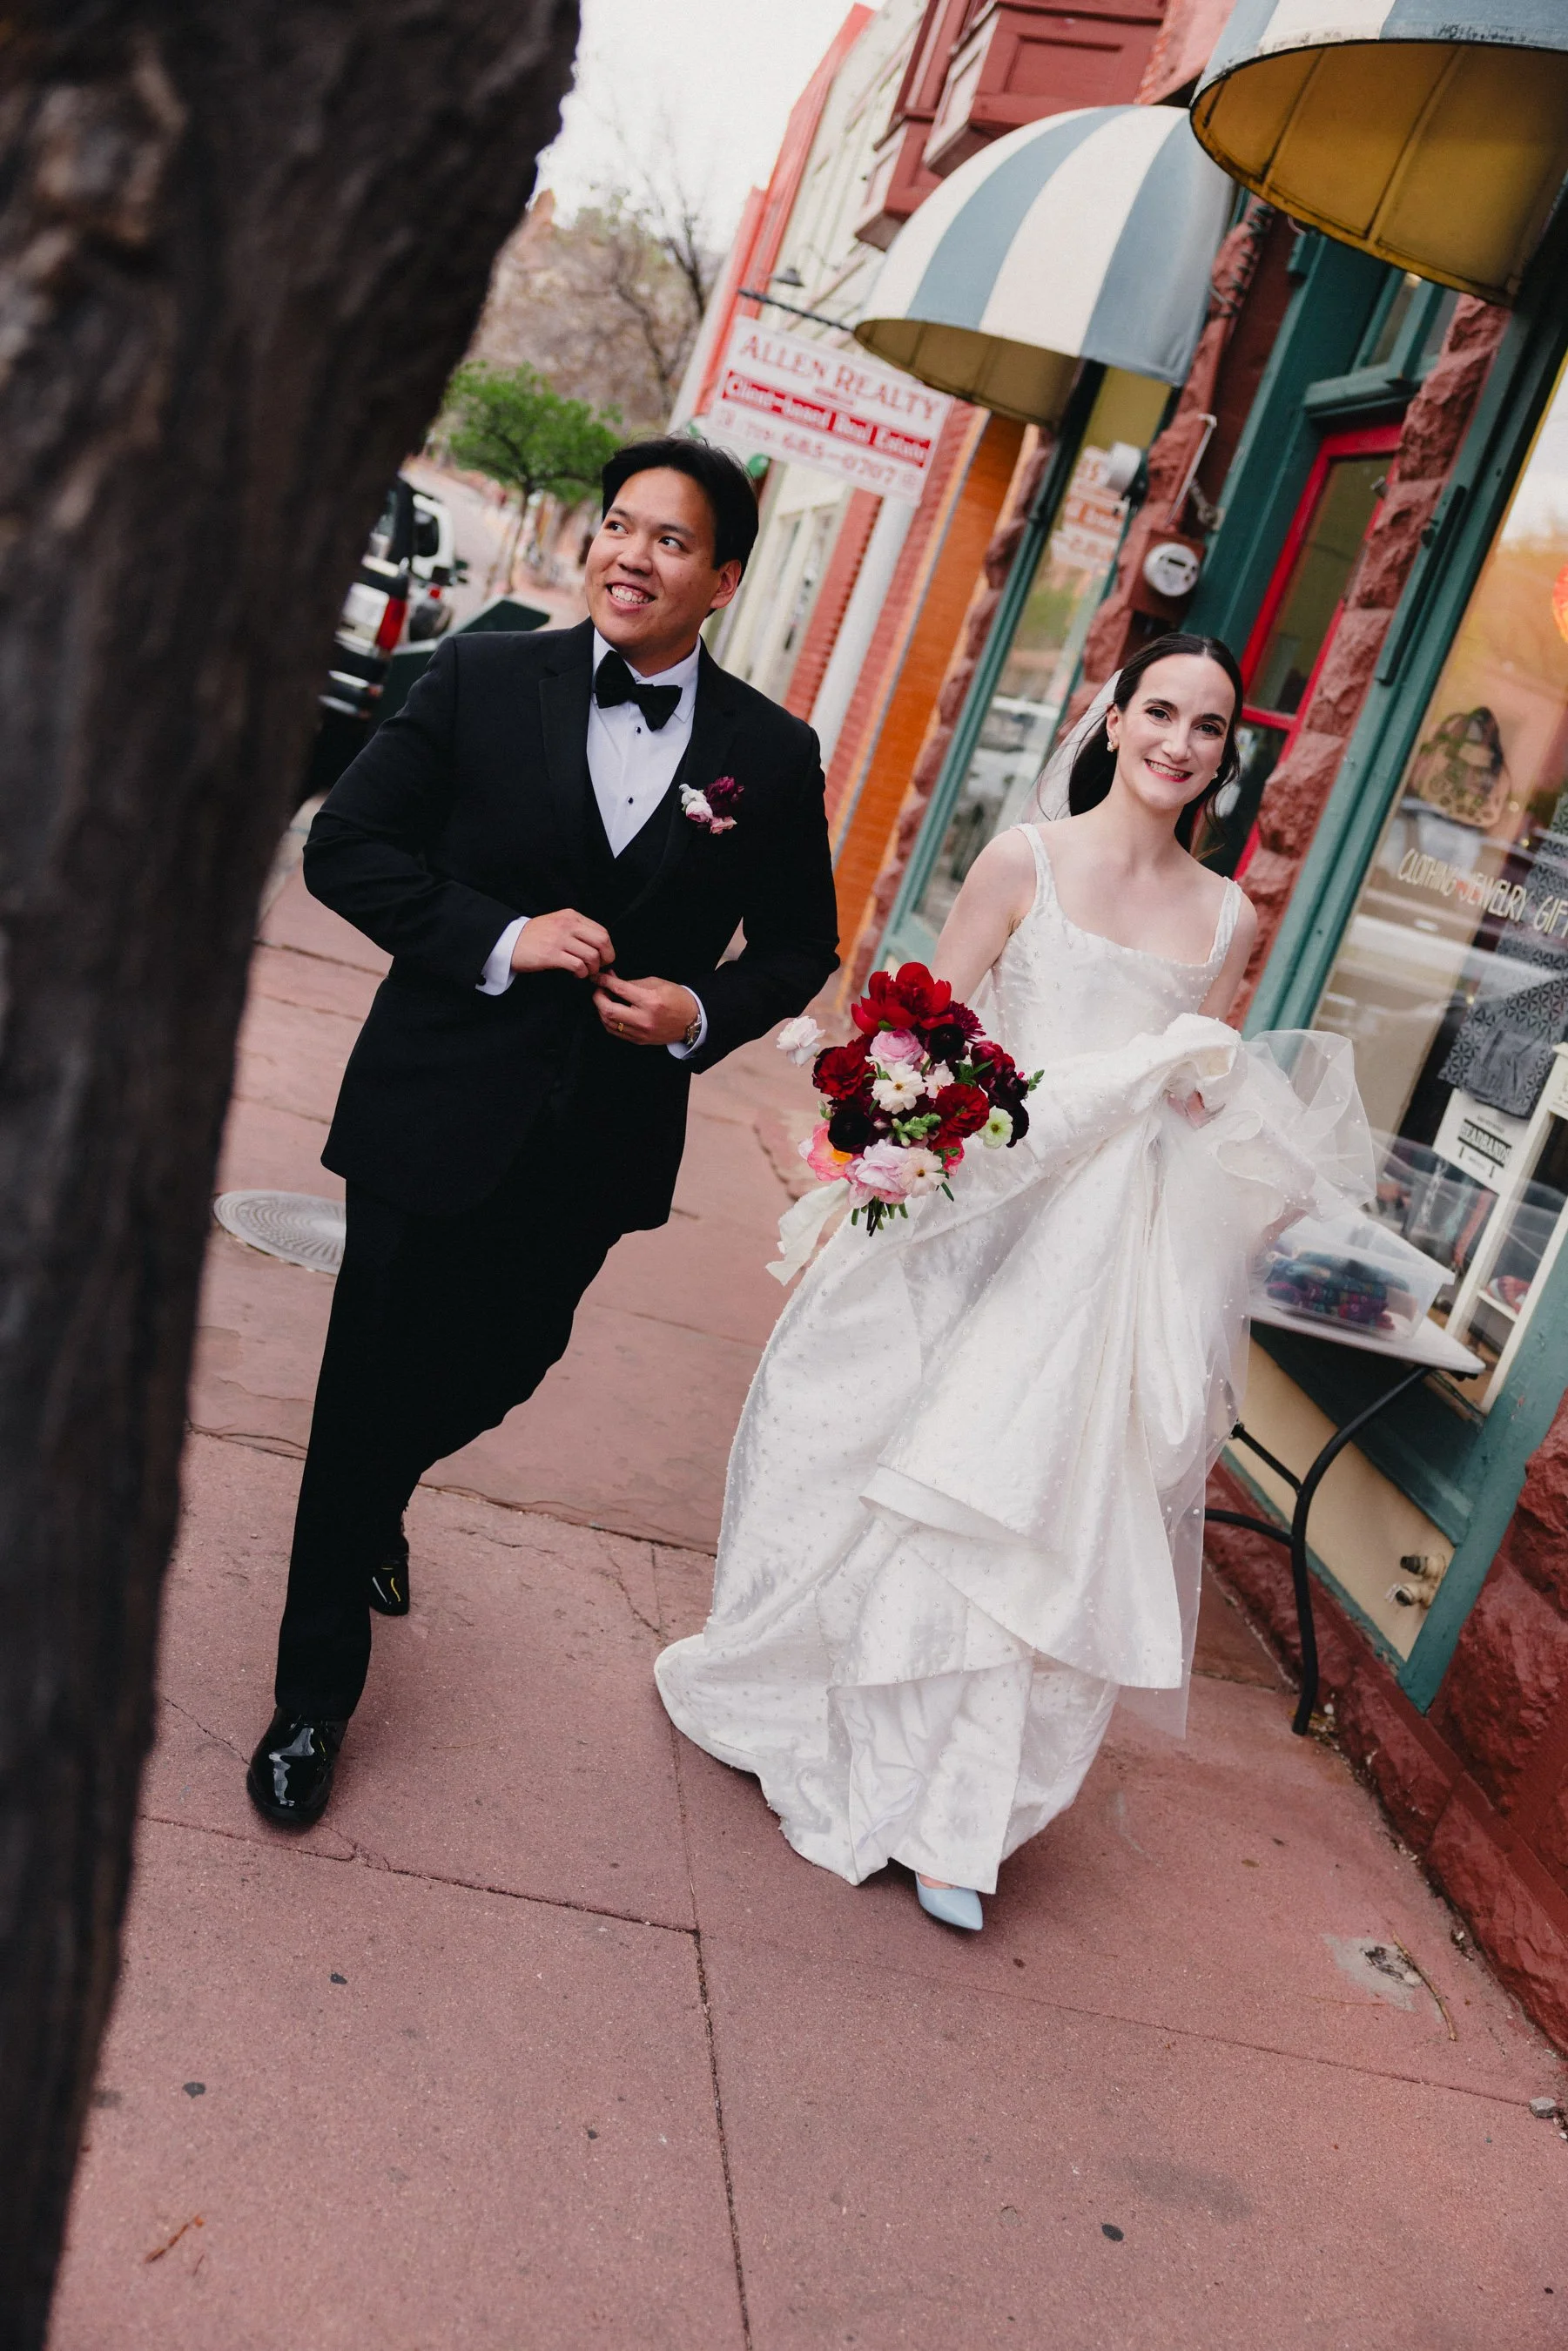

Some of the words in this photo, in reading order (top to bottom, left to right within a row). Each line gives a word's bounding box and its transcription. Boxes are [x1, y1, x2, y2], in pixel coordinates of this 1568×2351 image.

[739, 335, 828, 378] ALLEN
[835, 363, 941, 421] REALTY
[1396, 847, 1461, 897] CLOTHING
